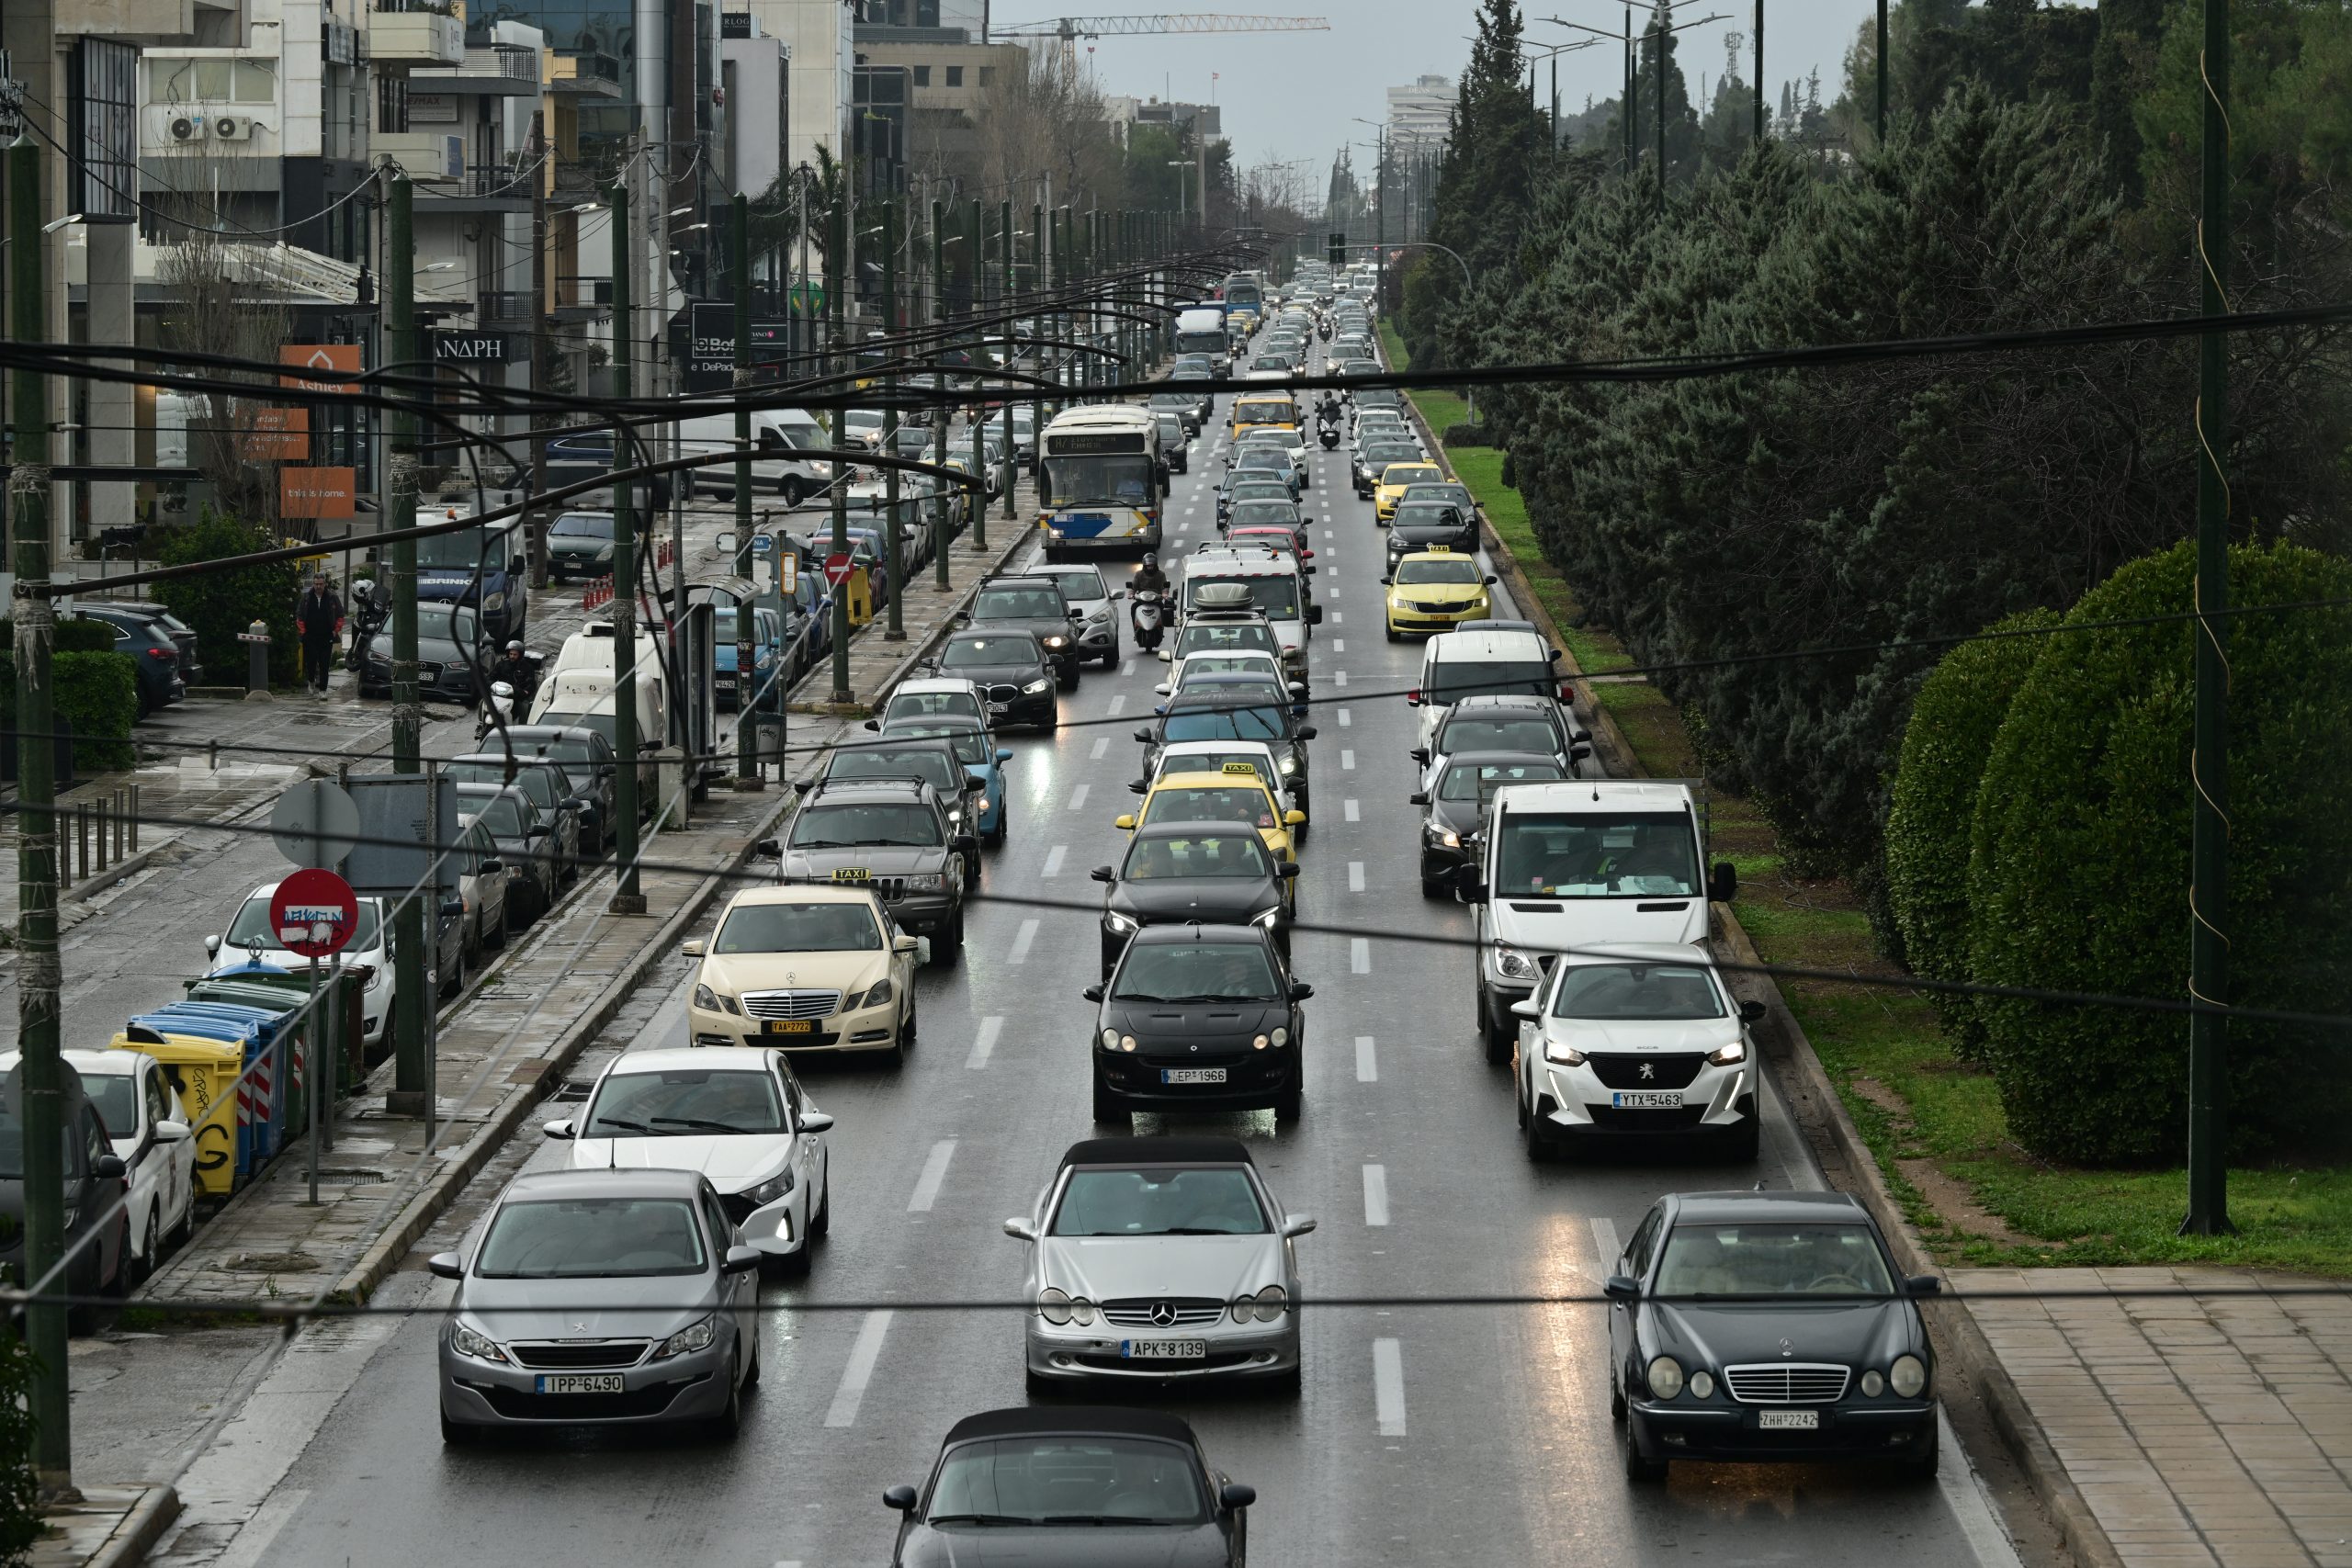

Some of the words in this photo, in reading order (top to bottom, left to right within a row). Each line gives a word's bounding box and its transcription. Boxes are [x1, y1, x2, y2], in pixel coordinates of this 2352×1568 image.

[702, 362, 735, 371] DePad
[309, 489, 316, 498] is
[838, 870, 864, 878] TAXI
[1170, 1071, 1225, 1082] EP-1966
[1134, 1342, 1204, 1356] APK-8139
